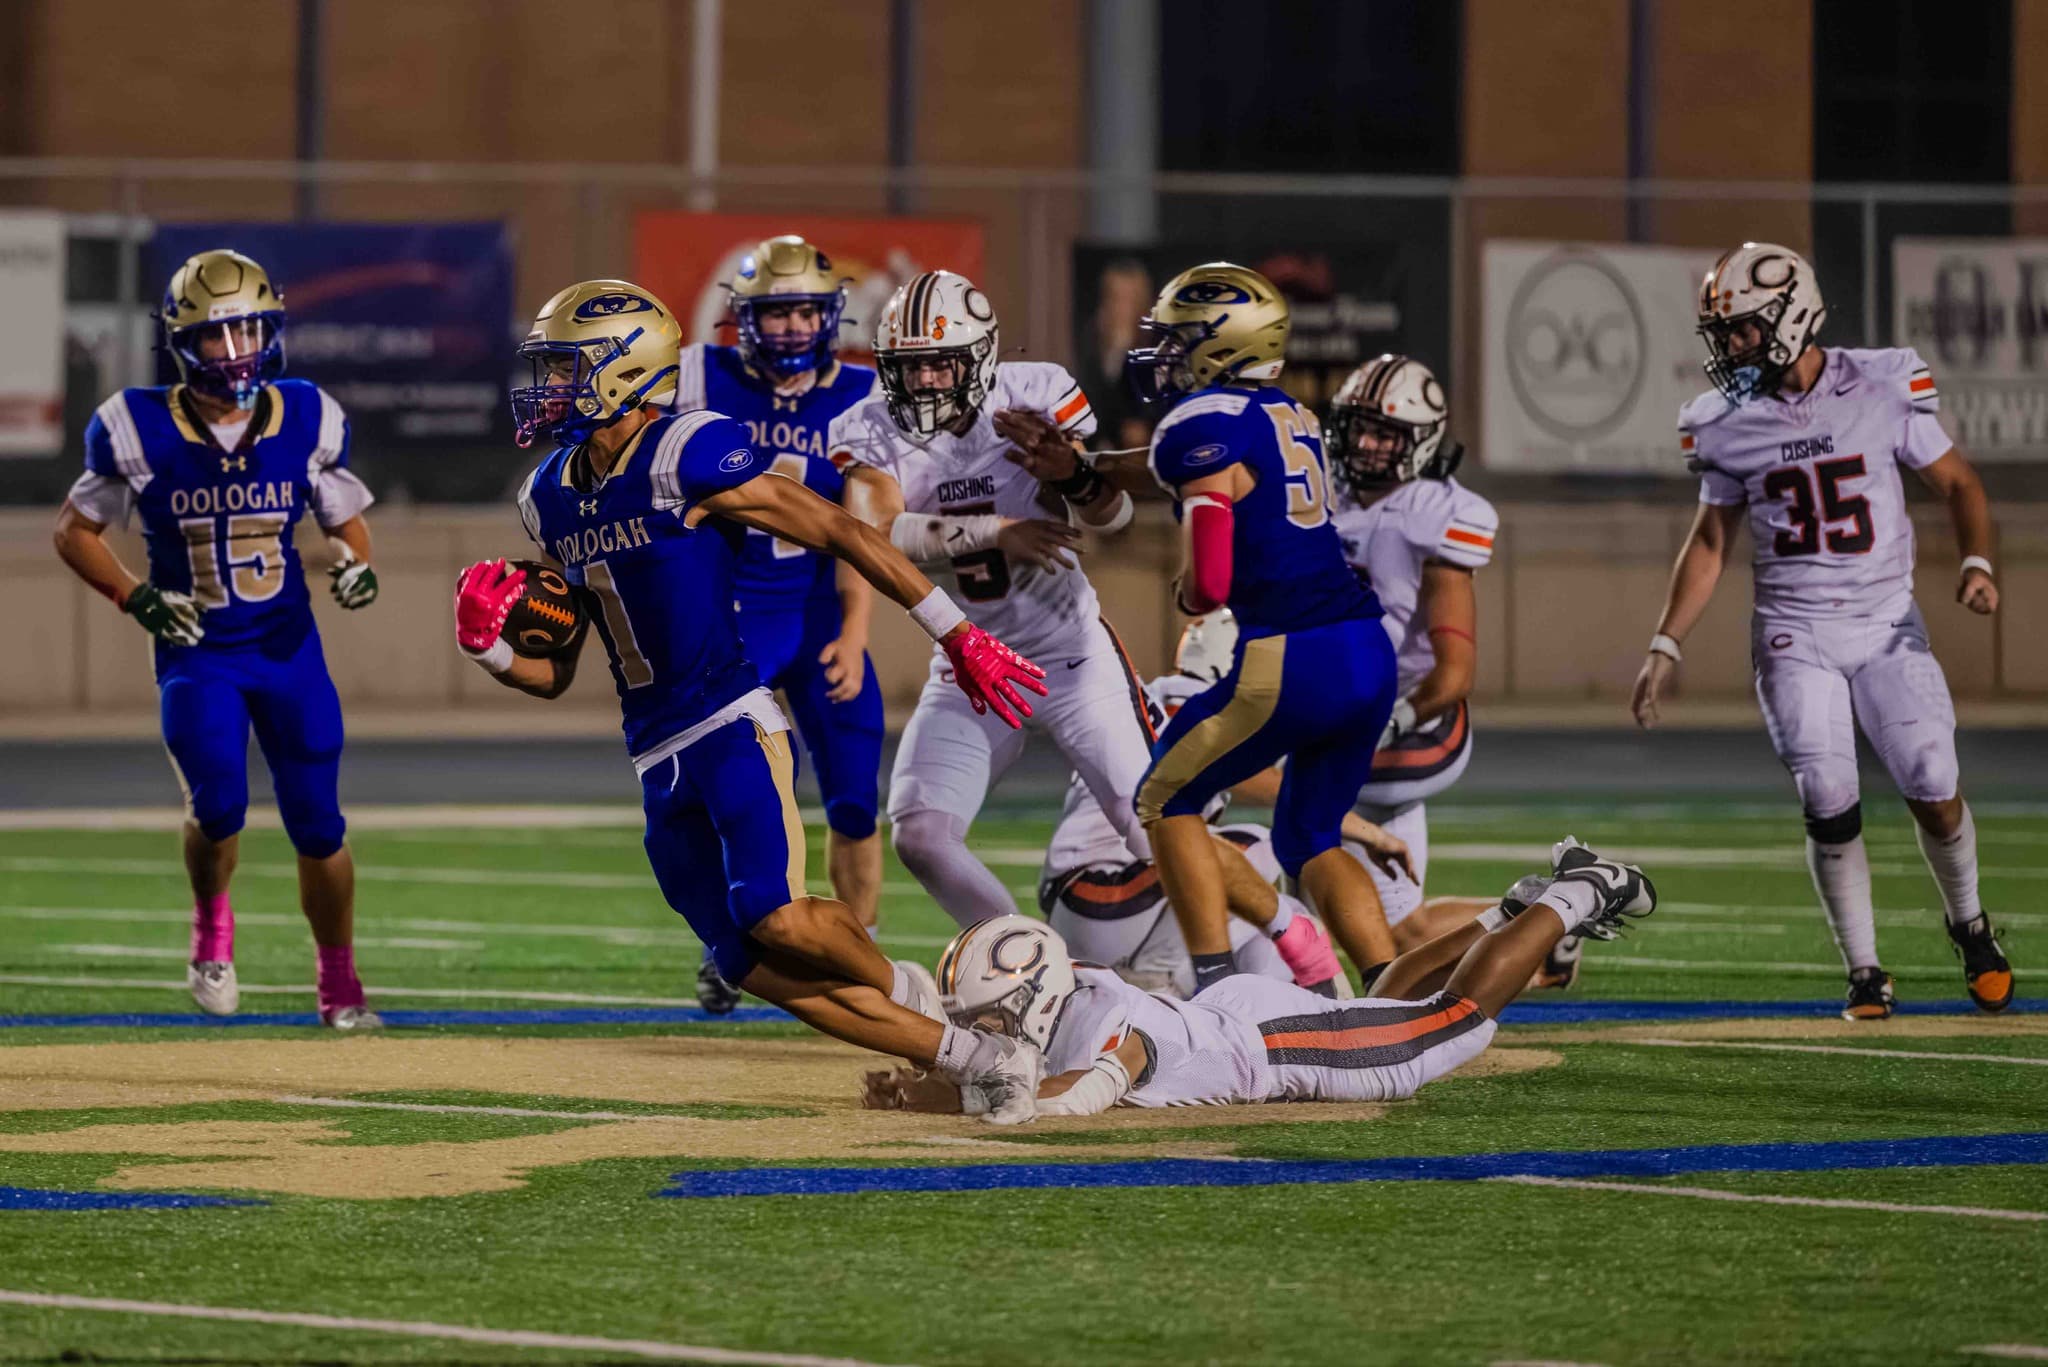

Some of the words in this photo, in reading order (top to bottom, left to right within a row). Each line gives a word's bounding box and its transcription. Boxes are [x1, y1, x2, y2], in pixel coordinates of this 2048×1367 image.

[1781, 436, 1834, 463] CUSHING
[170, 480, 294, 516] OOLOGAH
[937, 475, 994, 503] CUSHING
[1764, 453, 1875, 557] 35
[178, 511, 289, 609] 15
[555, 516, 652, 566] OOLOGAH
[582, 559, 654, 690] 1
